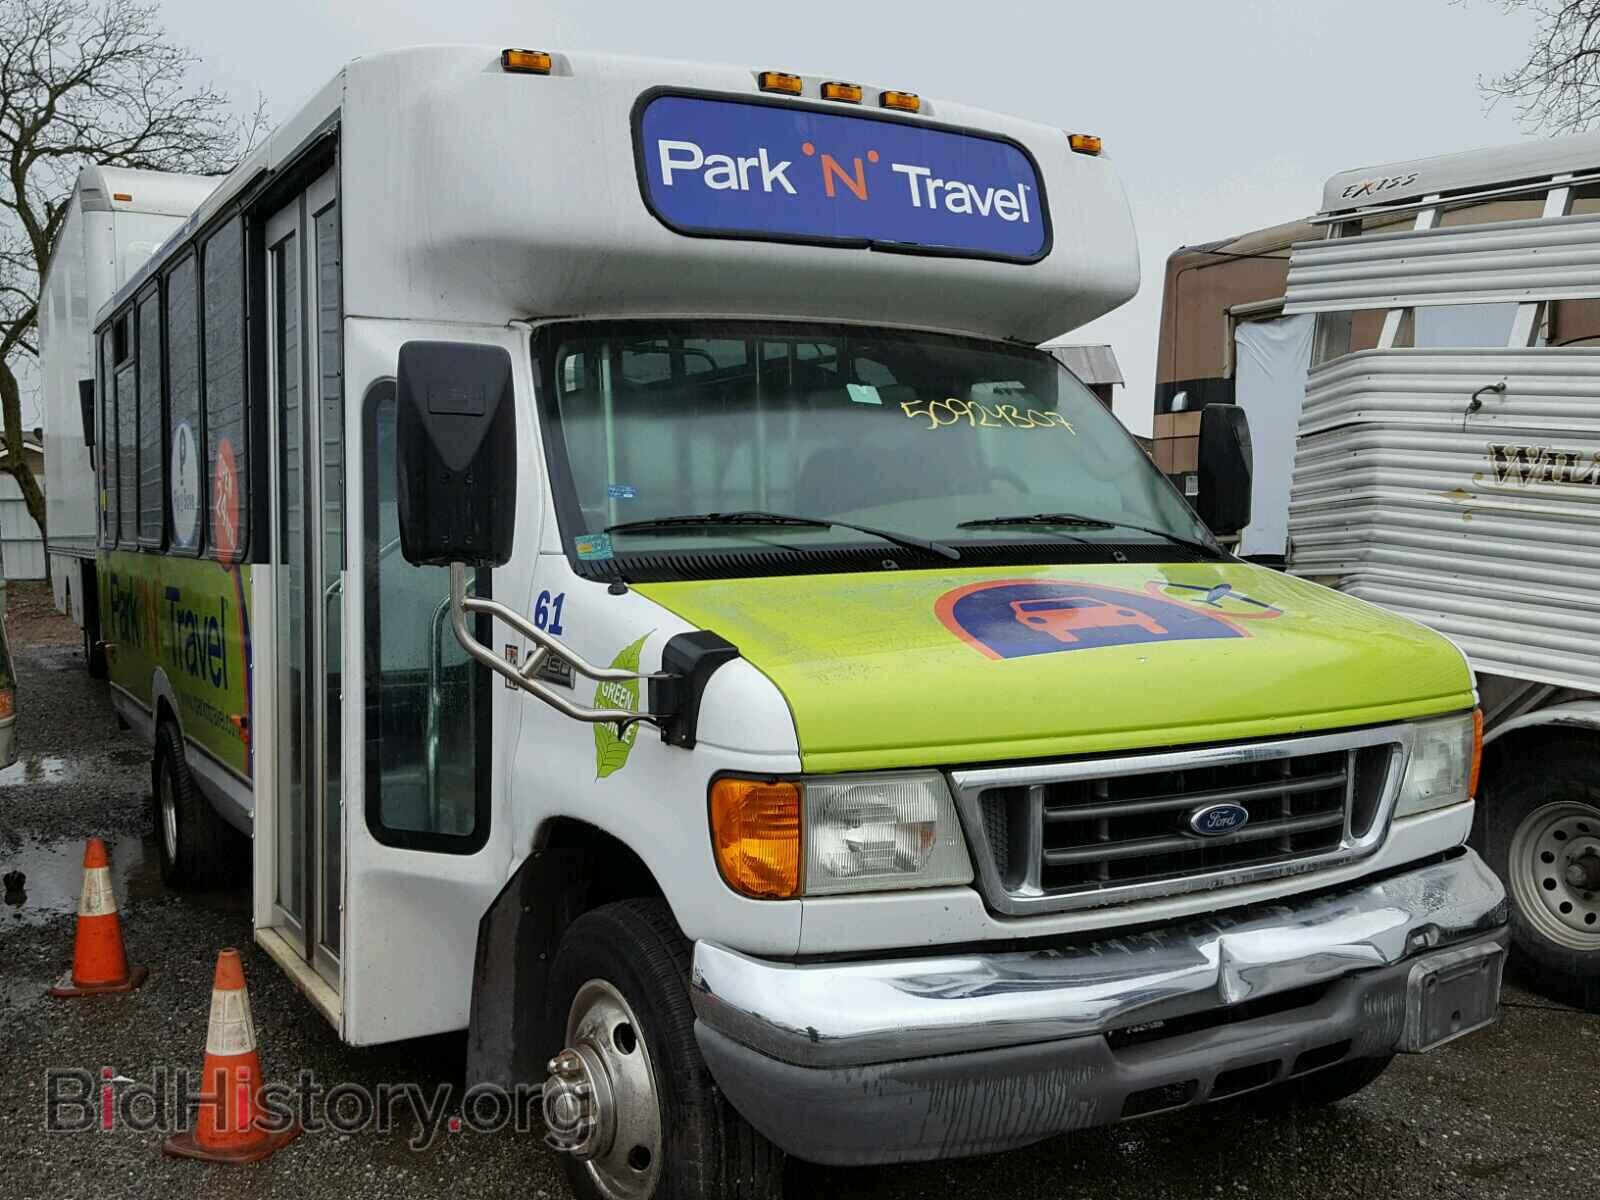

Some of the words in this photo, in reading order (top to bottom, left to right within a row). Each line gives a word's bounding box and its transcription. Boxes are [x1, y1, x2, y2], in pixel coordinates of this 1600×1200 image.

[657, 138, 798, 196] Park
[891, 163, 1031, 224] Travel
[1341, 172, 1420, 199] EXISS
[533, 589, 567, 637] 61
[165, 585, 229, 690] Travel
[600, 678, 635, 711] GREEN
[1207, 809, 1237, 829] Ford
